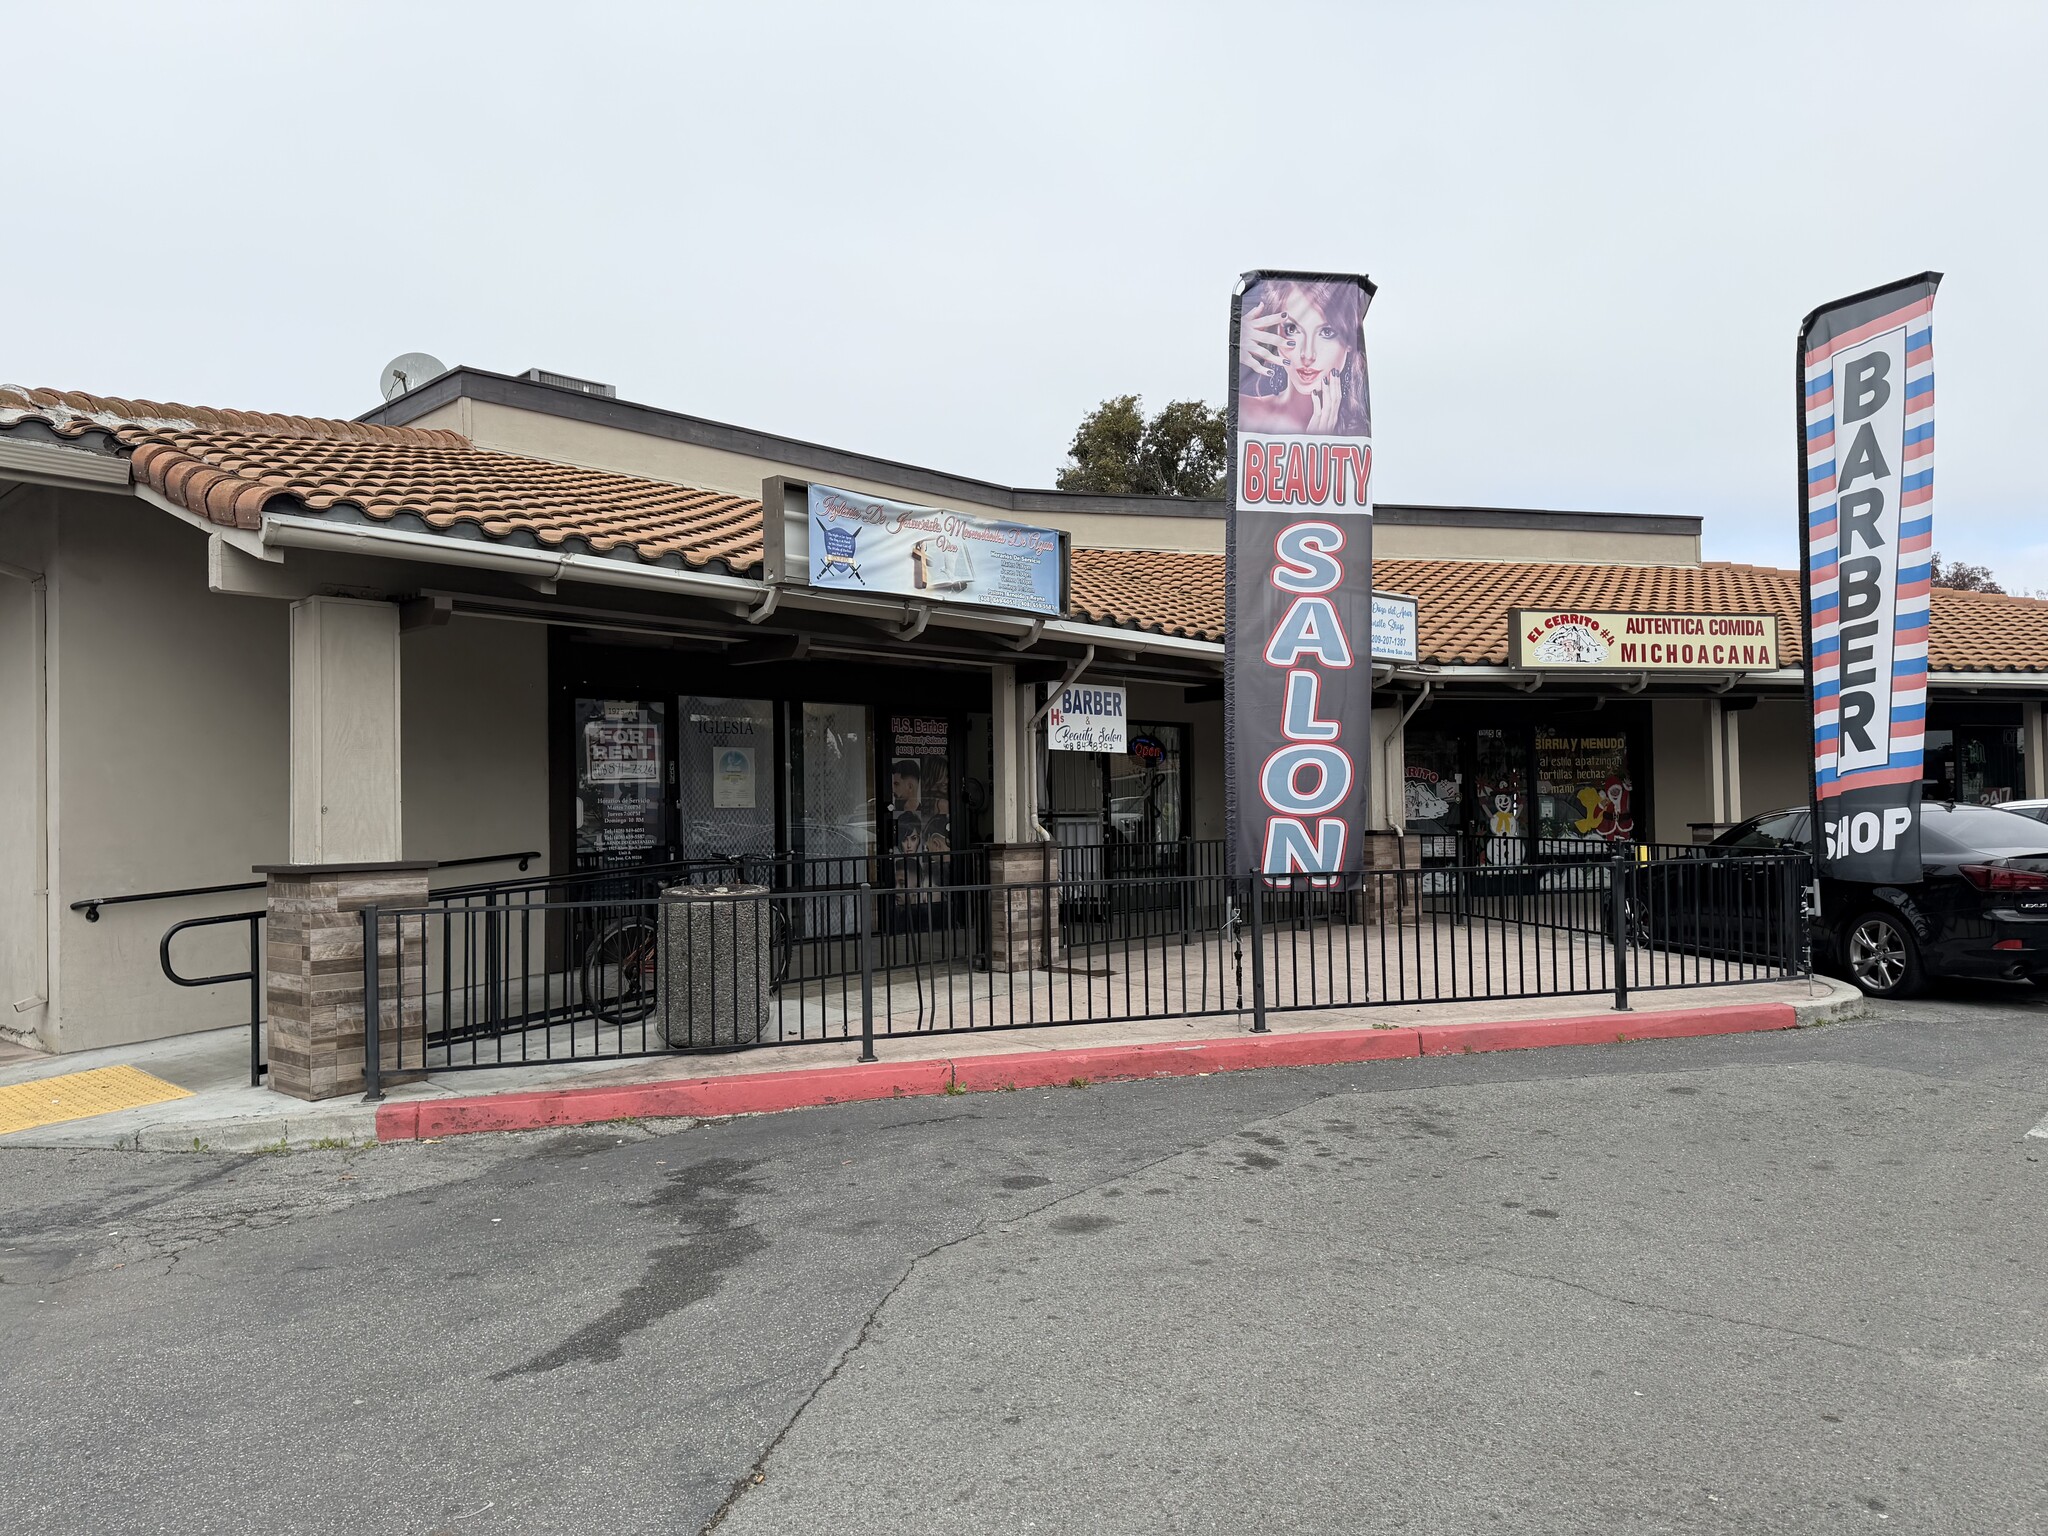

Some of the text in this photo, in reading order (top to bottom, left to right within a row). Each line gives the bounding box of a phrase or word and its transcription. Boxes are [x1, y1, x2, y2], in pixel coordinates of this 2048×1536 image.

[1243, 442, 1372, 505] BEAUTY
[1837, 351, 1891, 758] BARBER
[1527, 613, 1615, 647] EL CERRITO #4
[1625, 617, 1765, 637] AUTENTICA COMIDA
[1620, 642, 1771, 665] MICHOACANA
[1062, 689, 1122, 716] BARBER
[1259, 520, 1354, 888] SALON
[699, 720, 754, 734] IGLESIA
[892, 717, 948, 734] H.S. Barber
[1085, 716, 1090, 725] &
[600, 729, 644, 744] FOR
[1055, 725, 1122, 745] Beauty Salon
[591, 745, 652, 759] RENT
[1536, 738, 1570, 750] BIRRIA
[1581, 738, 1625, 749] MENUDO
[1540, 756, 1548, 767] al
[1404, 767, 1439, 784] RITO
[1539, 769, 1605, 780] tortillas hechas
[1541, 785, 1575, 794] a mano
[1825, 807, 1912, 860] SHOP
